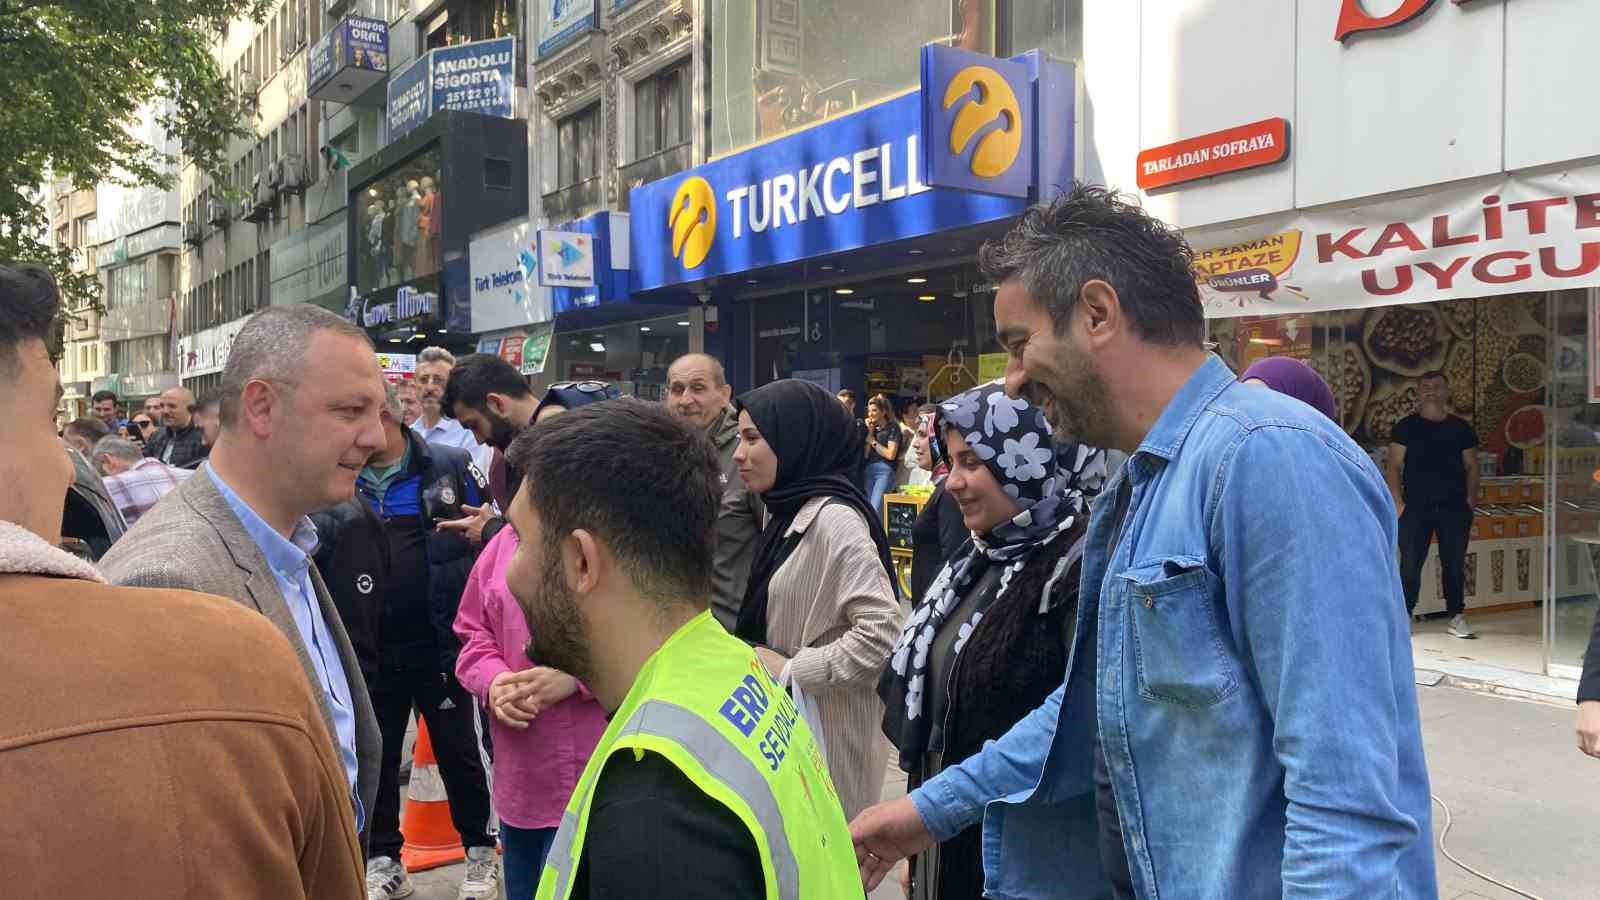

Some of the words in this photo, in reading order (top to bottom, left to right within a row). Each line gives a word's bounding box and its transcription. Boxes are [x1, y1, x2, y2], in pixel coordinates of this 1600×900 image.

[352, 28, 382, 43] ORAL
[434, 52, 510, 75] ANADOLU
[434, 69, 502, 90] SİGORTA
[1143, 148, 1210, 176] TARLADAN
[1212, 132, 1275, 160] SOFRAYA
[726, 134, 934, 240] TURKCELL
[1219, 236, 1284, 257] ZAMAN
[474, 276, 490, 293] Türk
[492, 269, 522, 288] Telekom
